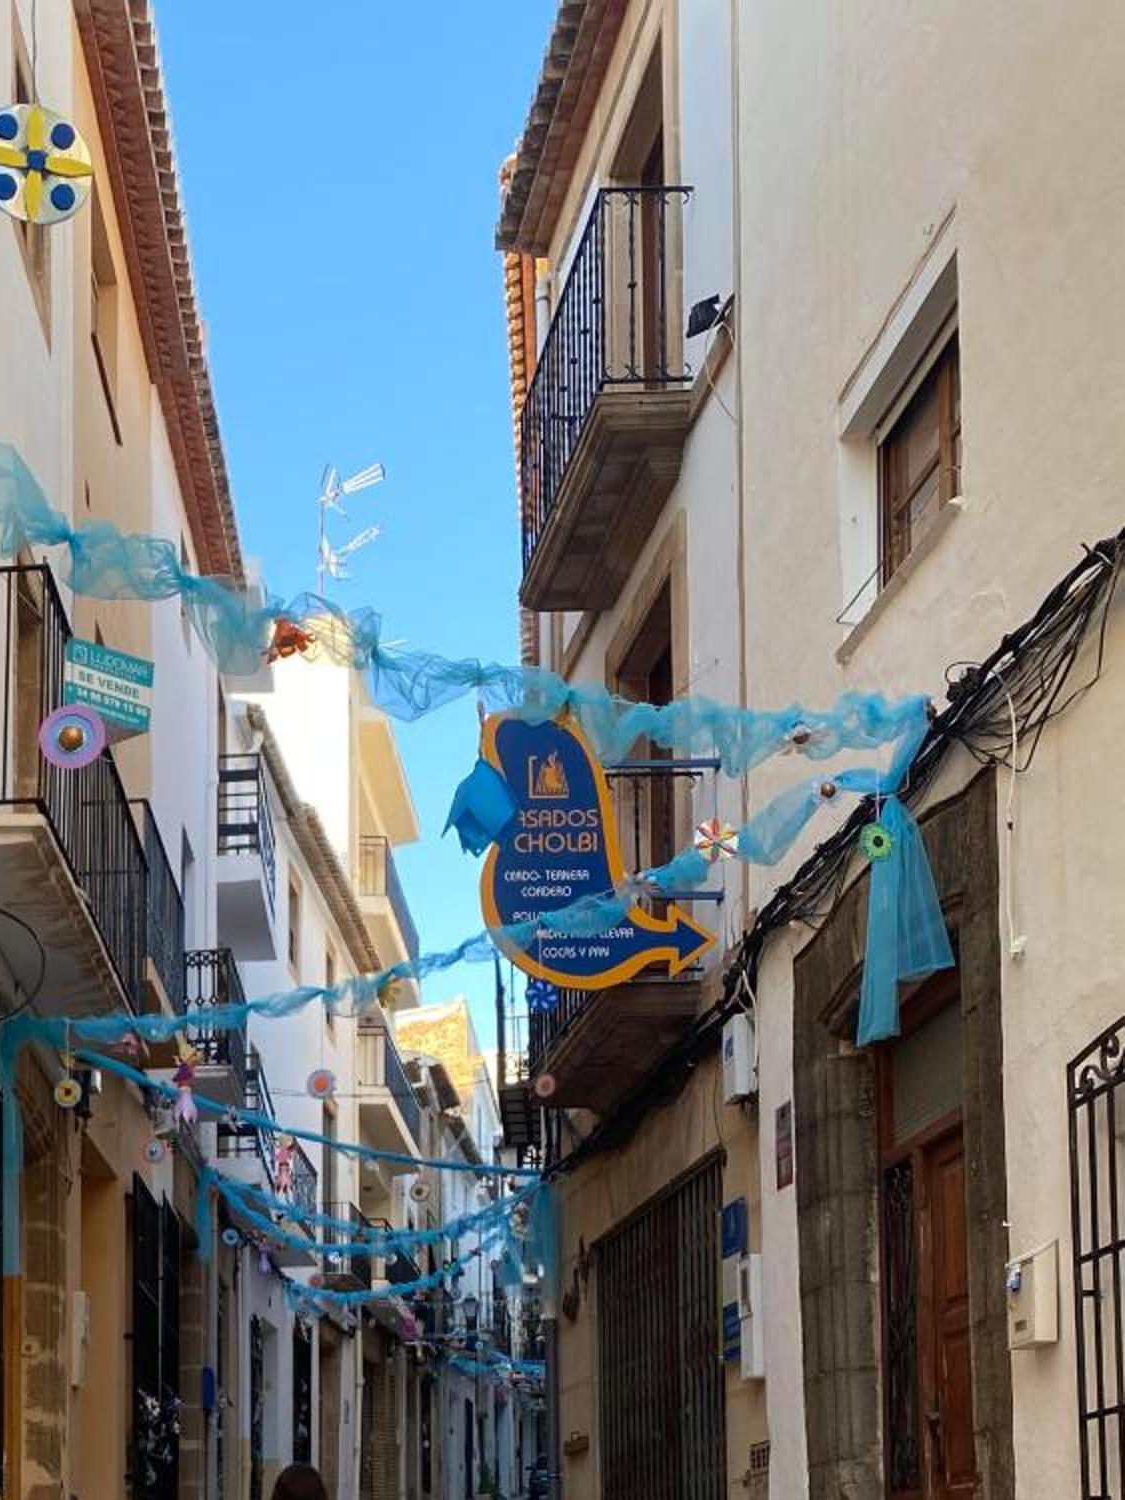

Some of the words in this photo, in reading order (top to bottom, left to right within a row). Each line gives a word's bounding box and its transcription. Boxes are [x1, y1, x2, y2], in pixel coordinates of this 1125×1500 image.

[78, 671, 94, 684] SE
[98, 675, 140, 700] VENDE
[514, 832, 598, 853] CHOLBI
[544, 869, 590, 881] TERNERA
[521, 885, 573, 897] CORDERO
[542, 946, 576, 959] COCAS
[578, 947, 586, 957] Y
[588, 945, 610, 958] PAN
